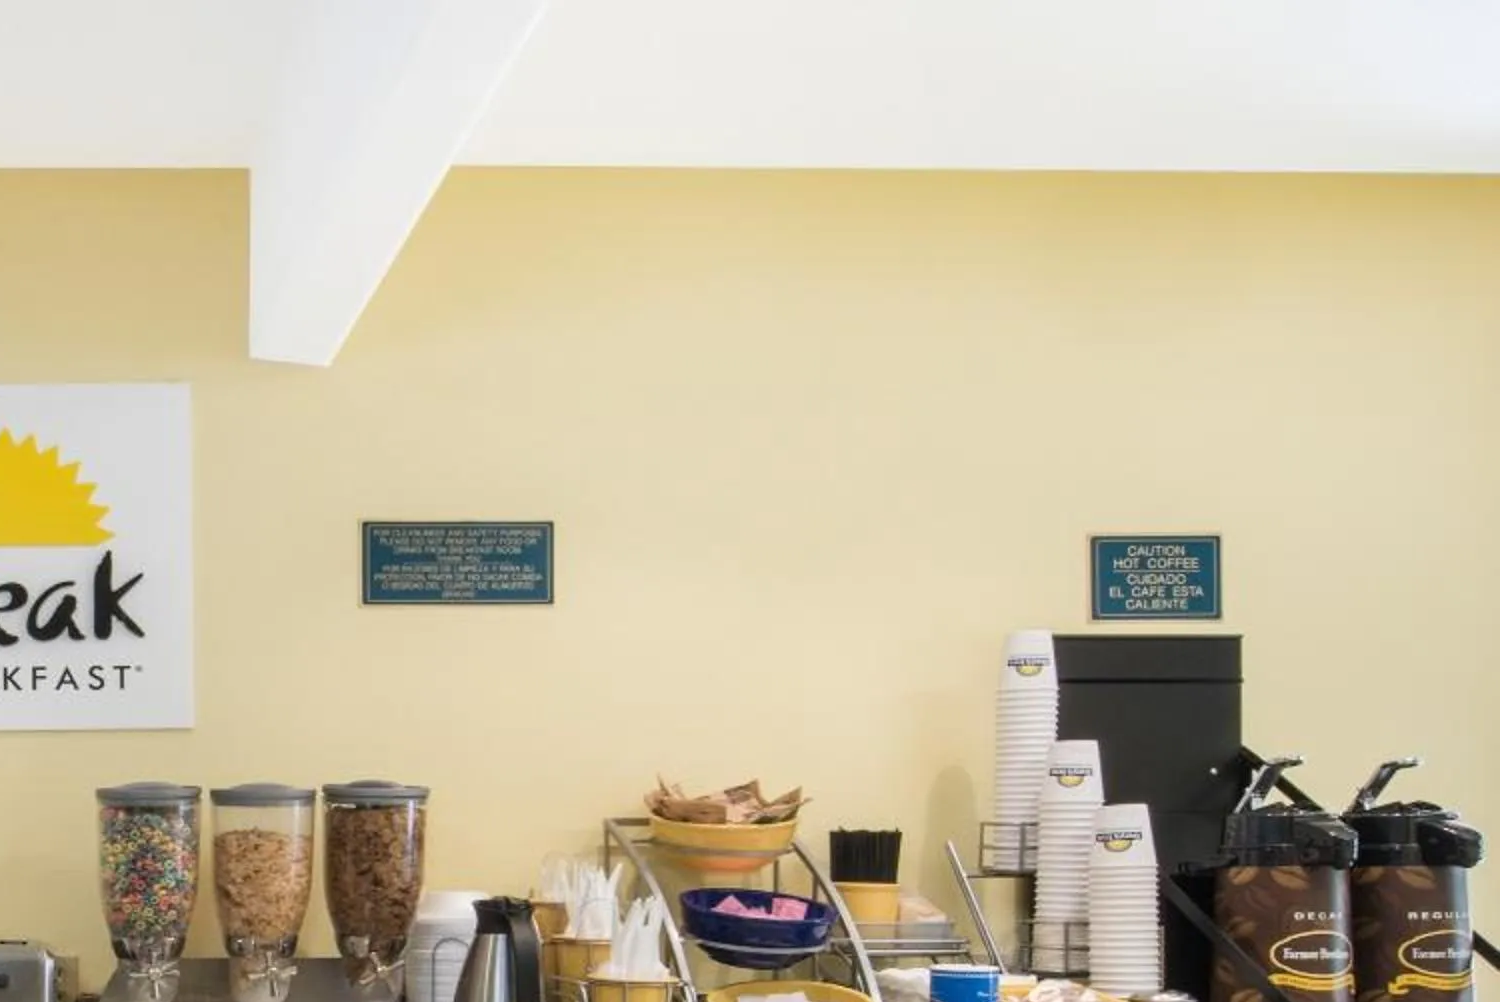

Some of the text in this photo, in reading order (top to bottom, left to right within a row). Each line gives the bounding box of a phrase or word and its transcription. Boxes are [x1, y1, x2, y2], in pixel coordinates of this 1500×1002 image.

[1127, 545, 1185, 557] CAUTION
[1113, 557, 1200, 569] HOT COFFEE
[1126, 573, 1187, 585] CUIDADO
[1109, 585, 1204, 598] EL CAFE ESTA
[1125, 599, 1189, 611] CALIENTE
